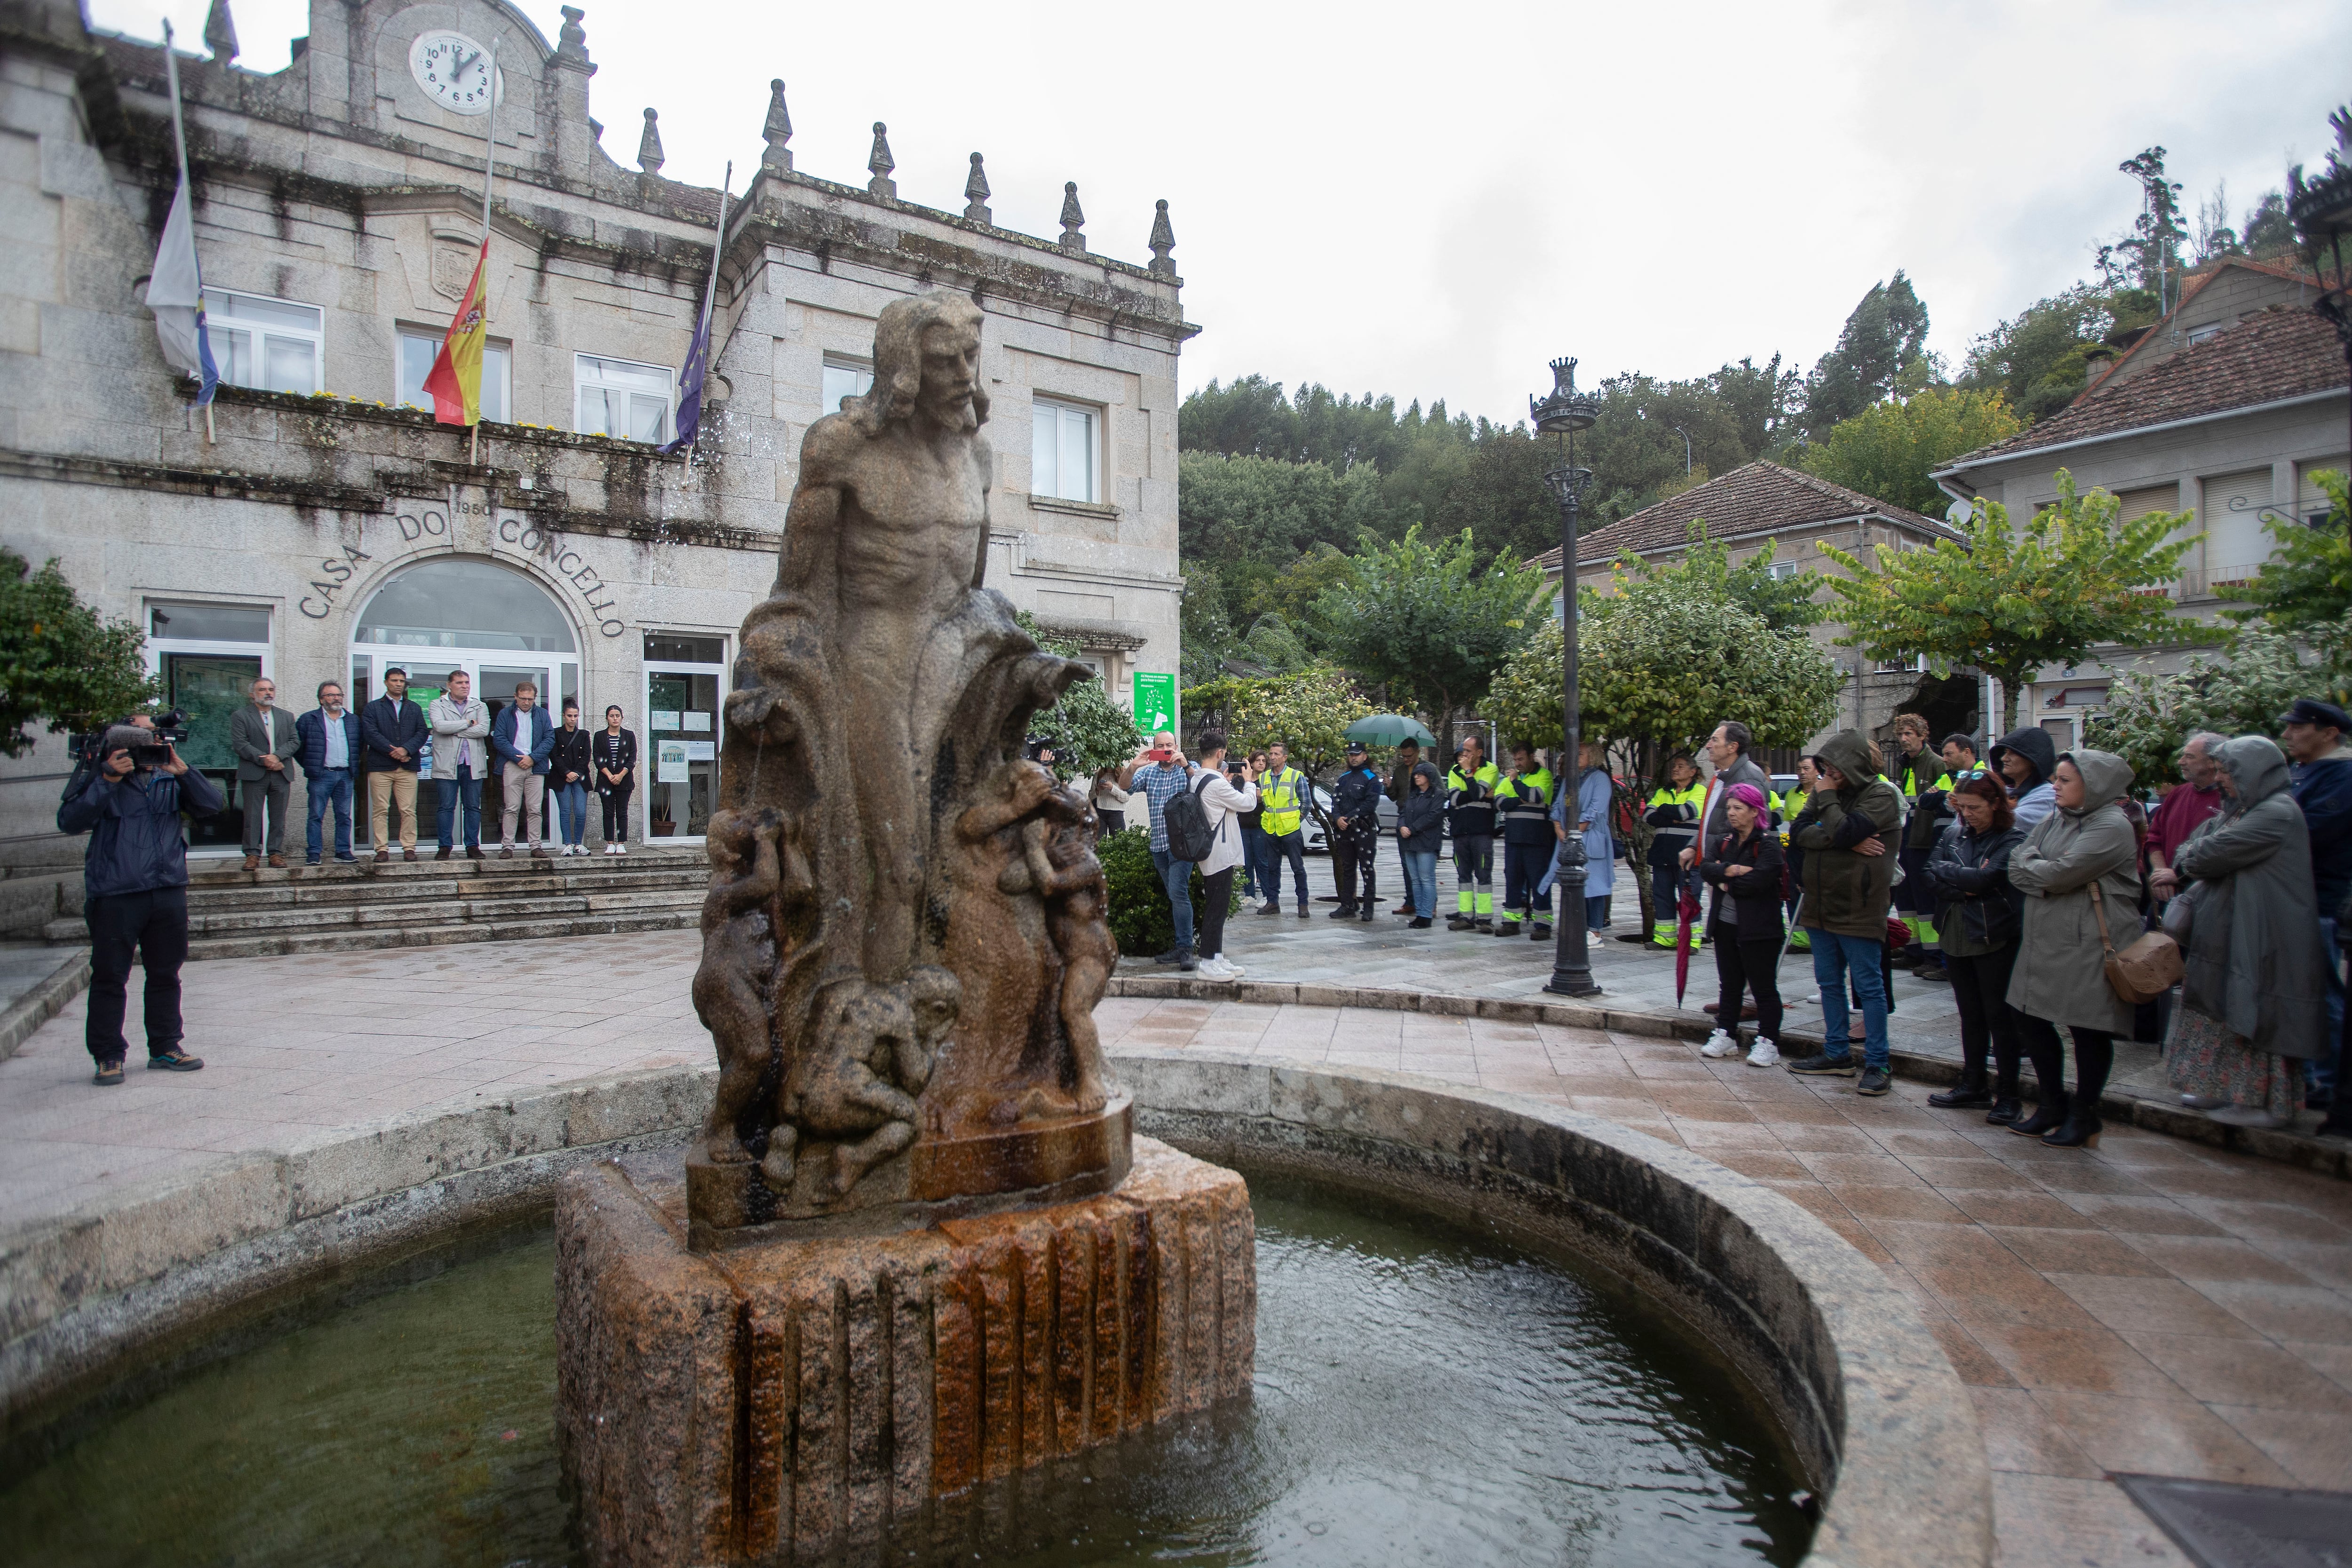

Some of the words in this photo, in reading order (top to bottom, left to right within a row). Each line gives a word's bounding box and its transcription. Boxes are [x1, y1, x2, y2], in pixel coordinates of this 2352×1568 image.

[440, 44, 447, 53] 11
[452, 45, 462, 55] 12
[427, 48, 439, 59] 10
[425, 59, 433, 69] 9
[477, 64, 485, 73] 2
[429, 73, 436, 82] 8
[481, 77, 487, 86] 3
[439, 84, 446, 93] 7
[477, 88, 484, 96] 4
[453, 92, 460, 101] 6
[467, 92, 474, 102] 5
[300, 545, 372, 619] CASA
[395, 511, 445, 541] DO
[500, 519, 624, 638] CONCELLO
